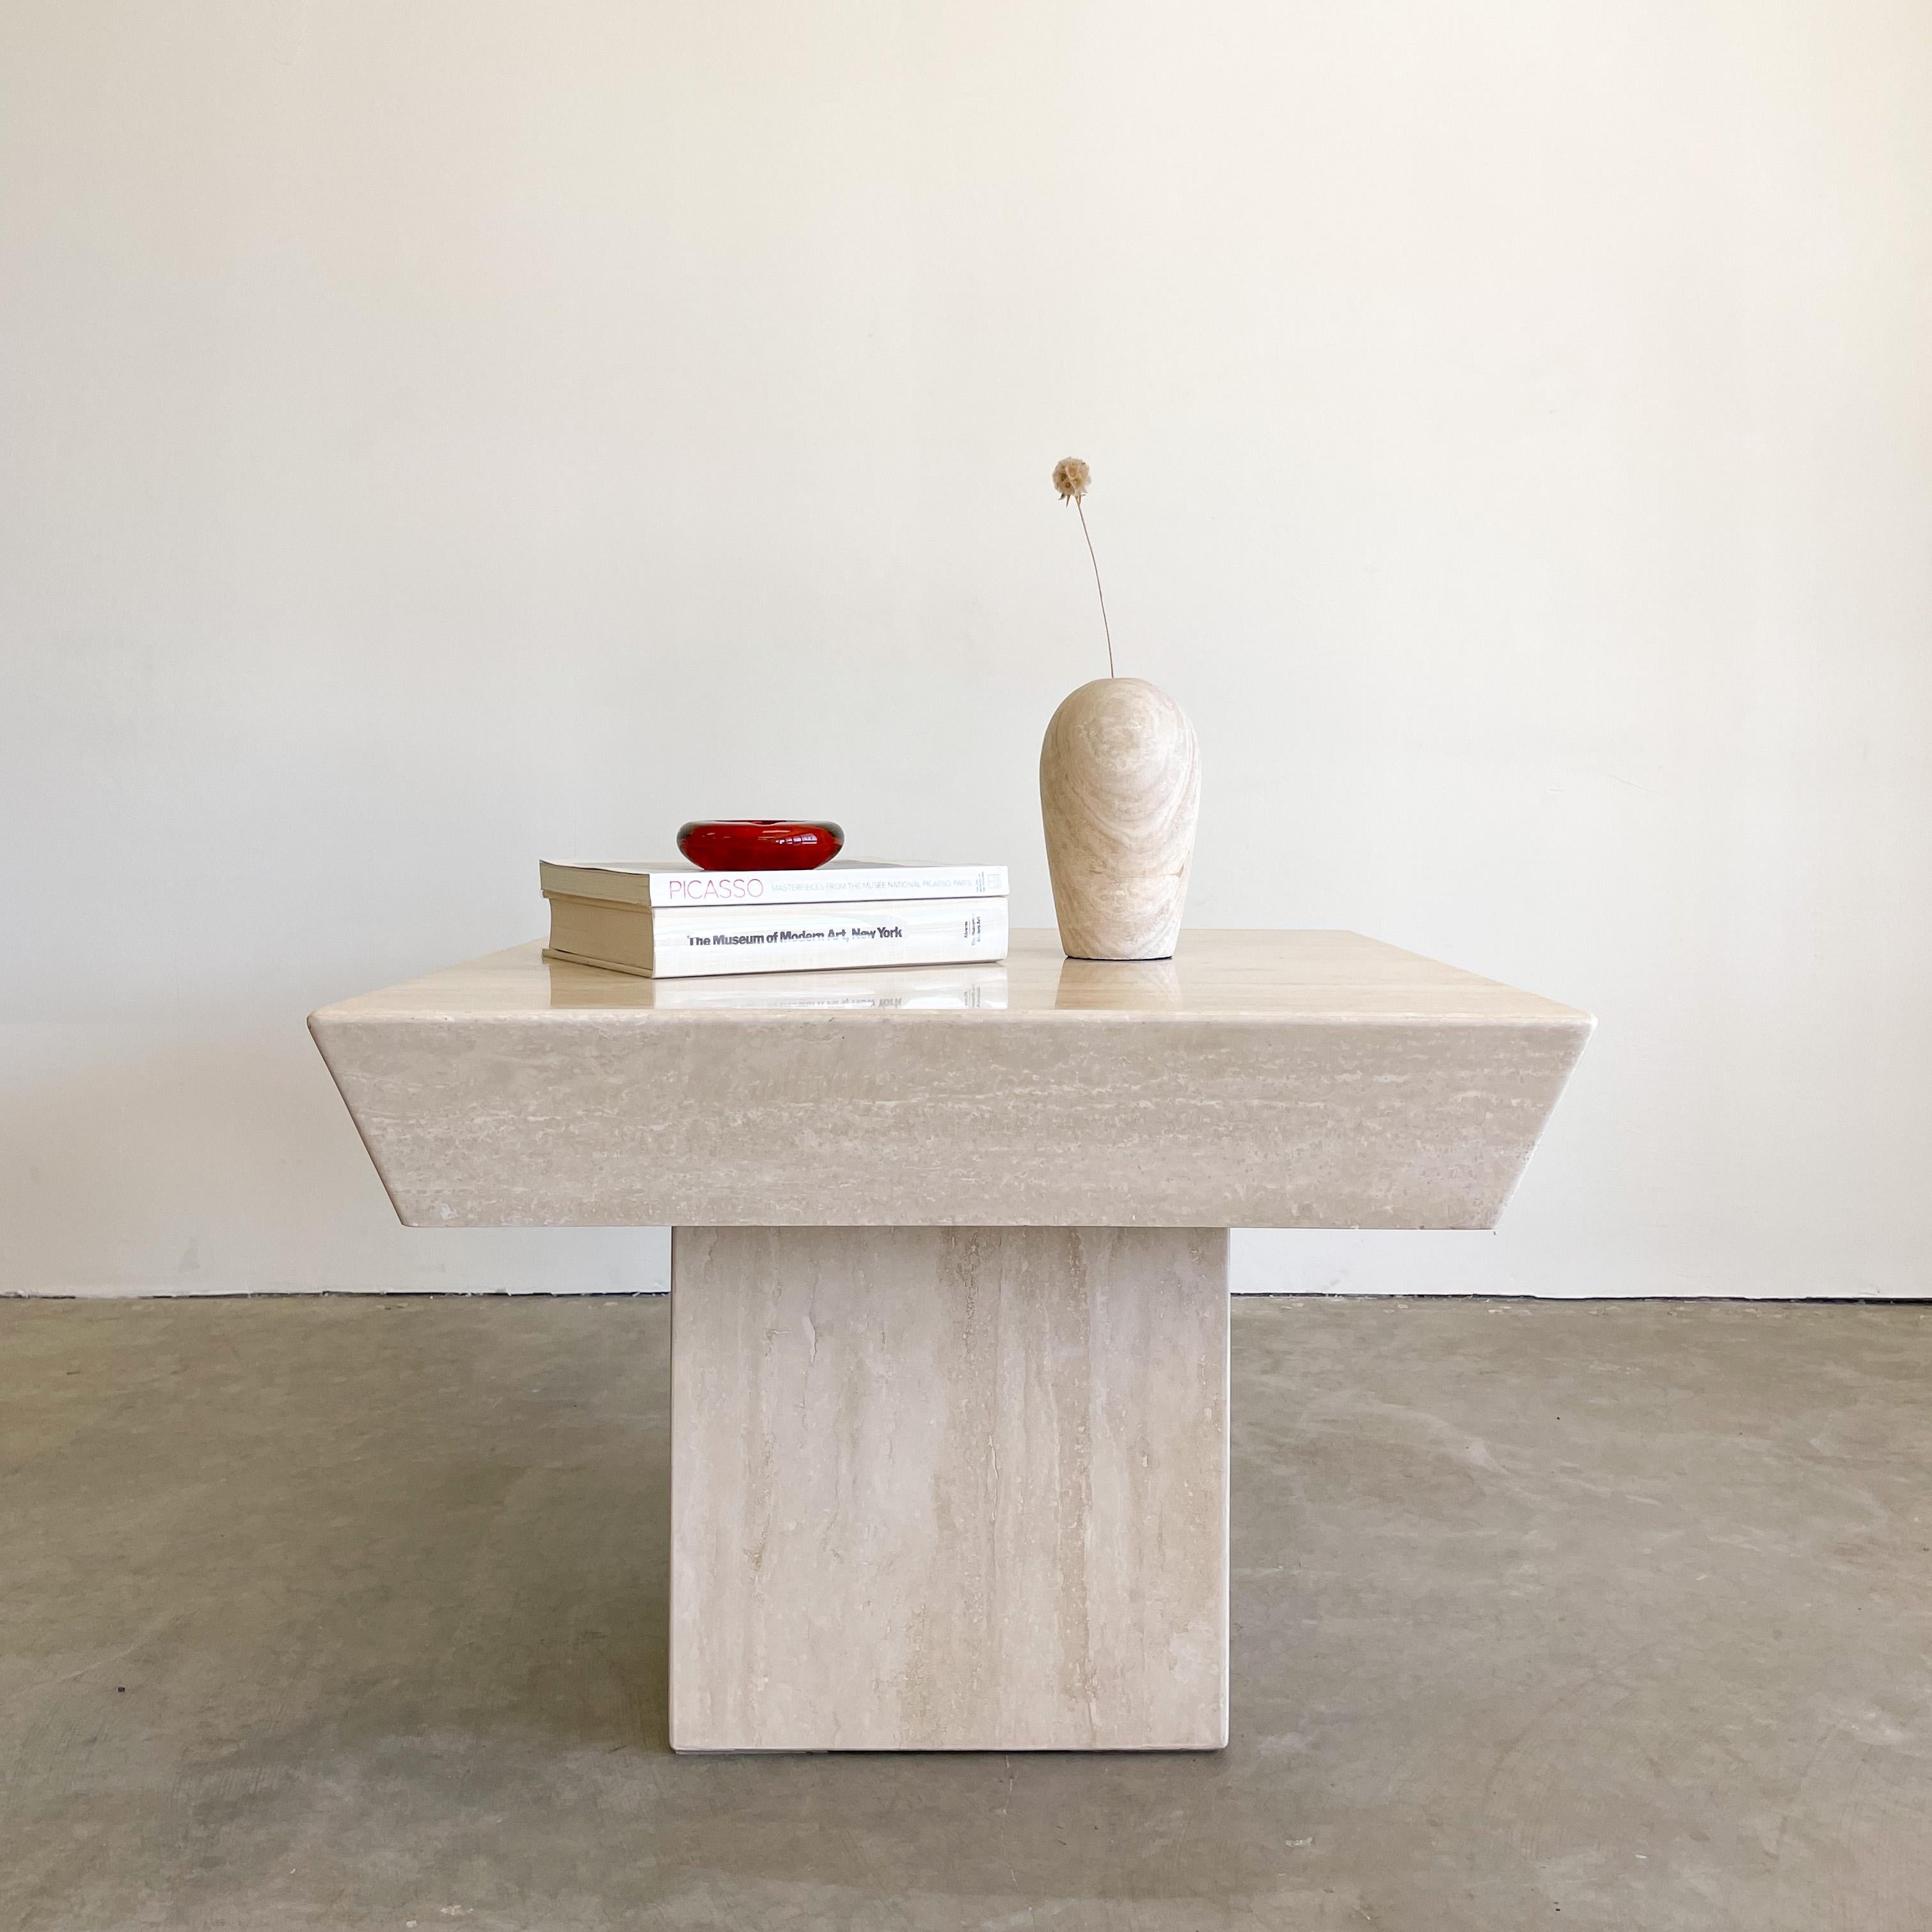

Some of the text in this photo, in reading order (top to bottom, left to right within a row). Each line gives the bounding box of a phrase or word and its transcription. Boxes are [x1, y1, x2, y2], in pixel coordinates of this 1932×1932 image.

[669, 878, 764, 899] PICASSO
[772, 882, 825, 892] MASTERPIECES
[826, 882, 846, 891] FROM
[848, 882, 861, 890] THE
[887, 880, 921, 888] NATIONAL
[687, 935, 711, 946] The
[713, 934, 764, 946] Museum
[766, 931, 779, 944] of
[780, 930, 825, 943] Modern
[851, 928, 876, 940] New
[876, 926, 903, 938] York
